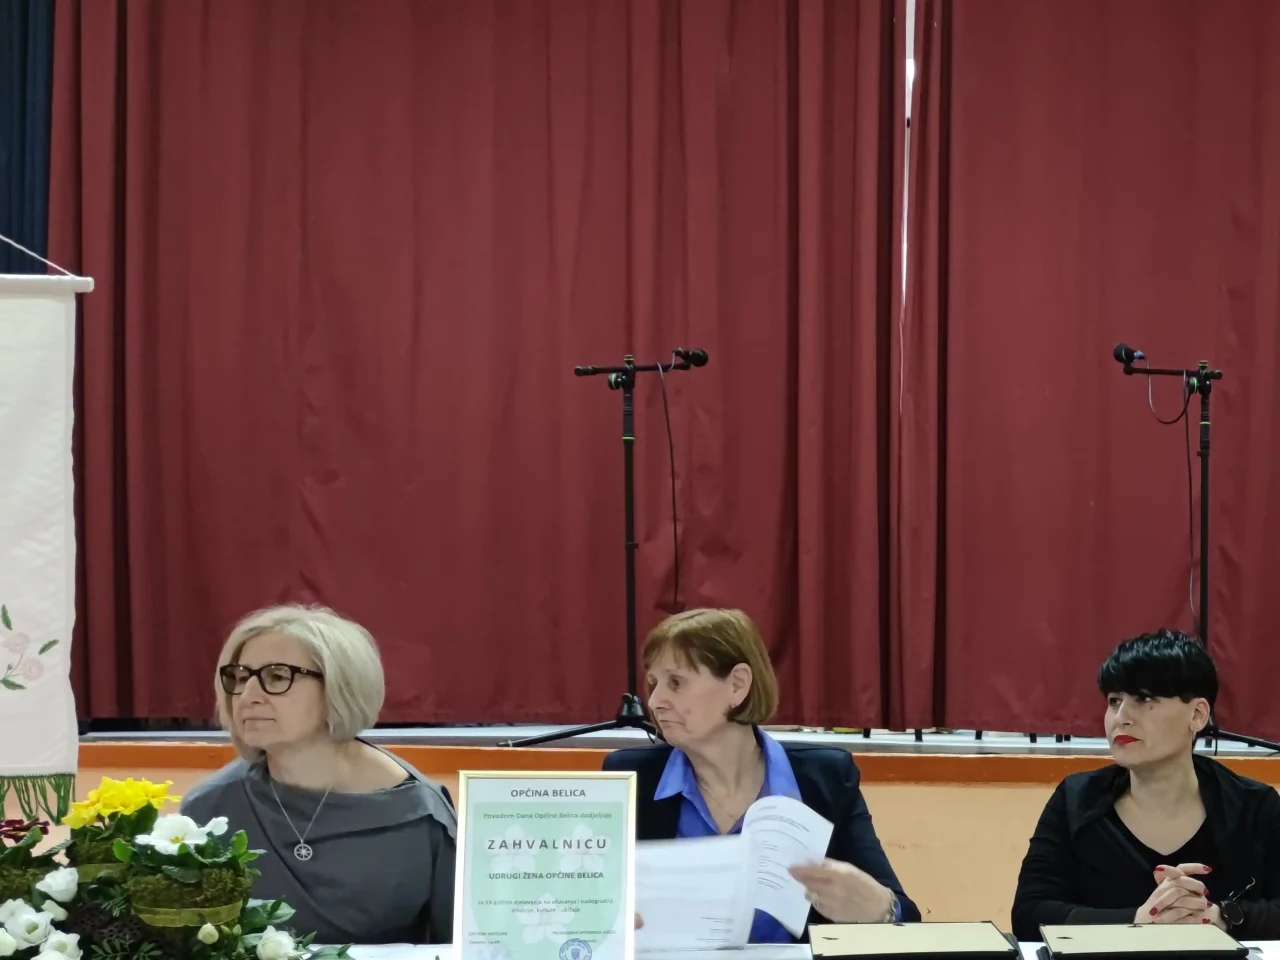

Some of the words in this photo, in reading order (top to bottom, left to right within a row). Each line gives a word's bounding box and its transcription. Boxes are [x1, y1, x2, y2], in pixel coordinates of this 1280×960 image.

[510, 787, 549, 798] OPĆINA
[552, 789, 586, 798] BELICA
[483, 812, 515, 820] Povodom
[516, 812, 533, 820] Dana
[559, 812, 578, 820] Belica
[580, 811, 613, 821] dodjeljuje
[487, 838, 607, 850] ZAHVALNICU
[488, 872, 521, 880] UDRUGI
[522, 871, 544, 880] ŽENA
[545, 870, 575, 879] OPĆINE
[577, 871, 604, 879] BELICA
